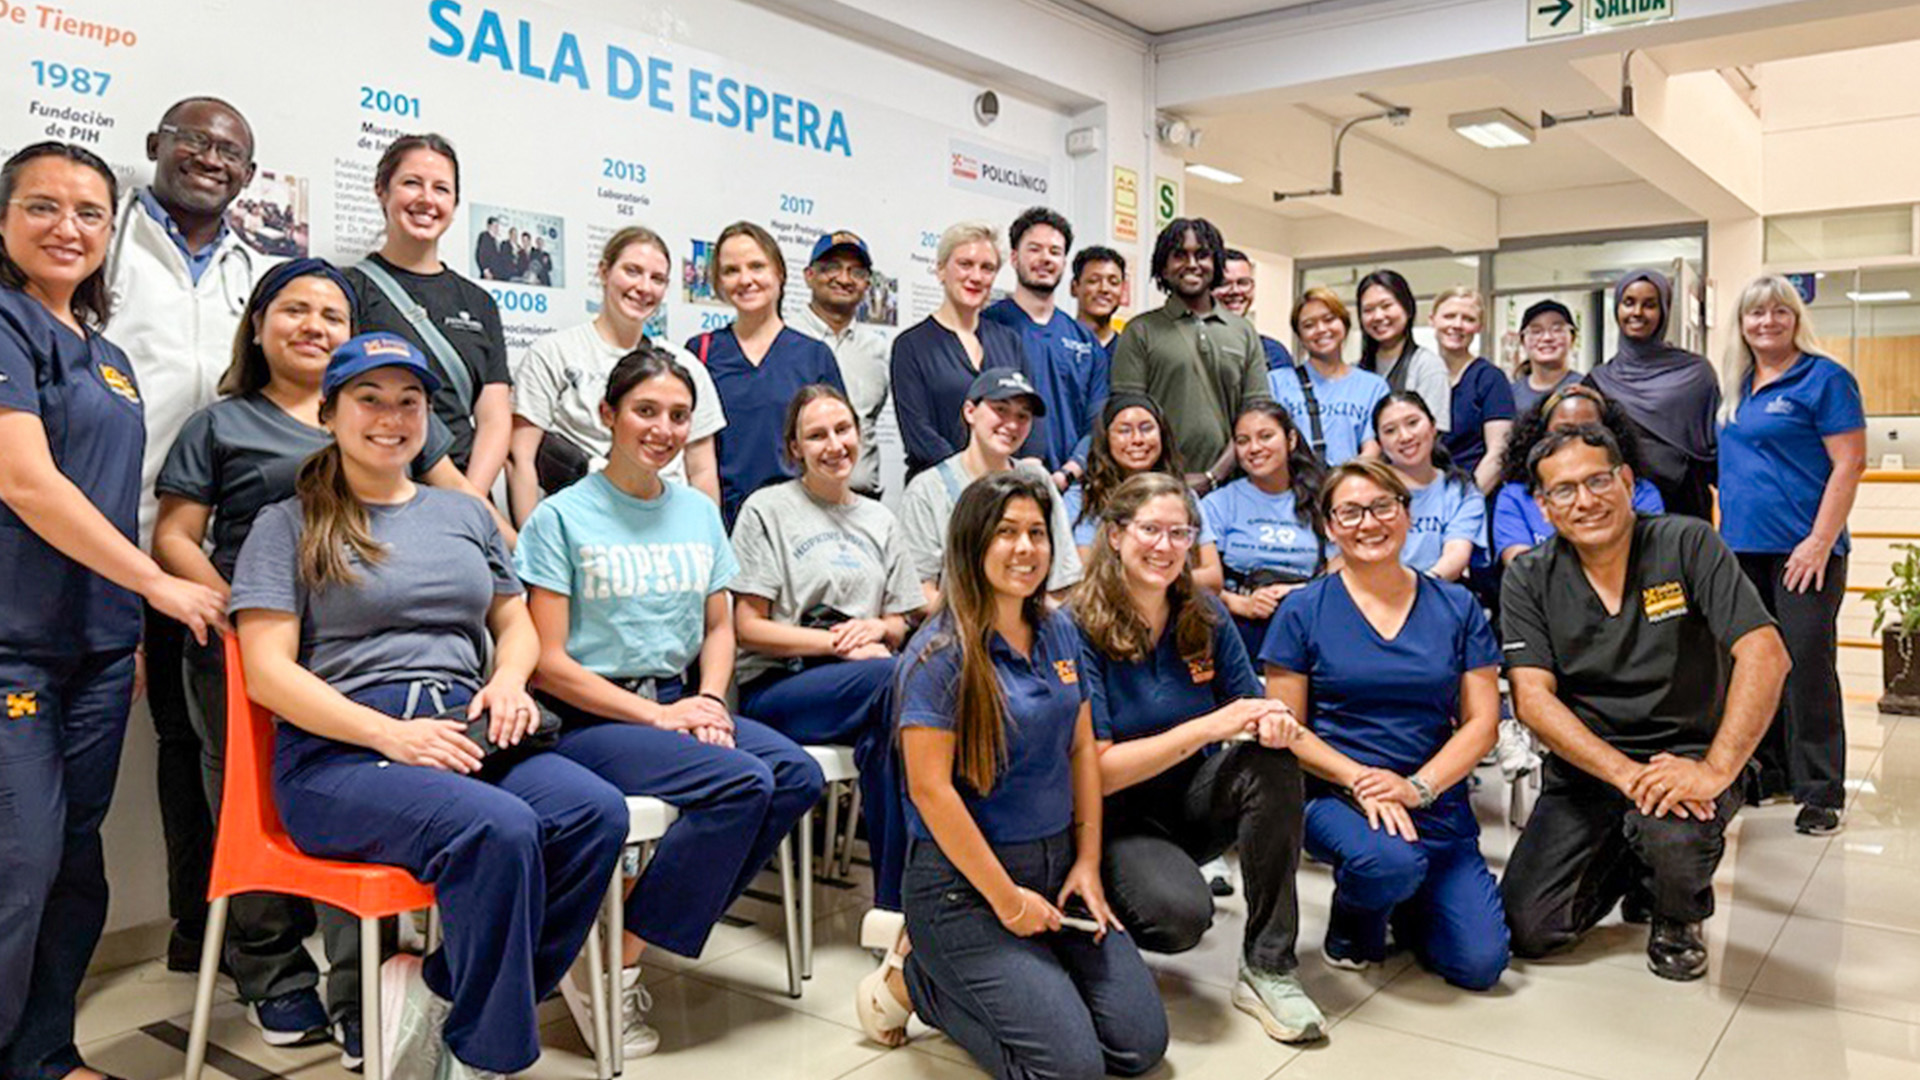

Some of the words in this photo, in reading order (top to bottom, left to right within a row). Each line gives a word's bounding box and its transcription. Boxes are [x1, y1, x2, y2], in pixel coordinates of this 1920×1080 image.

[35, 4, 138, 47] Tiempo
[30, 59, 112, 97] 1987
[428, 0, 591, 91] SALA
[606, 44, 674, 113] DE
[688, 67, 853, 158] ESPERA
[360, 86, 420, 119] 2001
[45, 122, 66, 138] de
[69, 125, 100, 143] PIH
[357, 138, 372, 150] de
[602, 157, 647, 184] 2013
[982, 163, 1048, 195] POLICLÍNICO
[597, 186, 651, 206] Laboratorio
[780, 194, 815, 216] 2017
[1160, 184, 1175, 219] S
[617, 203, 635, 217] SES
[491, 289, 547, 313] 2008
[701, 311, 739, 330] 201
[1260, 525, 1296, 545] 20
